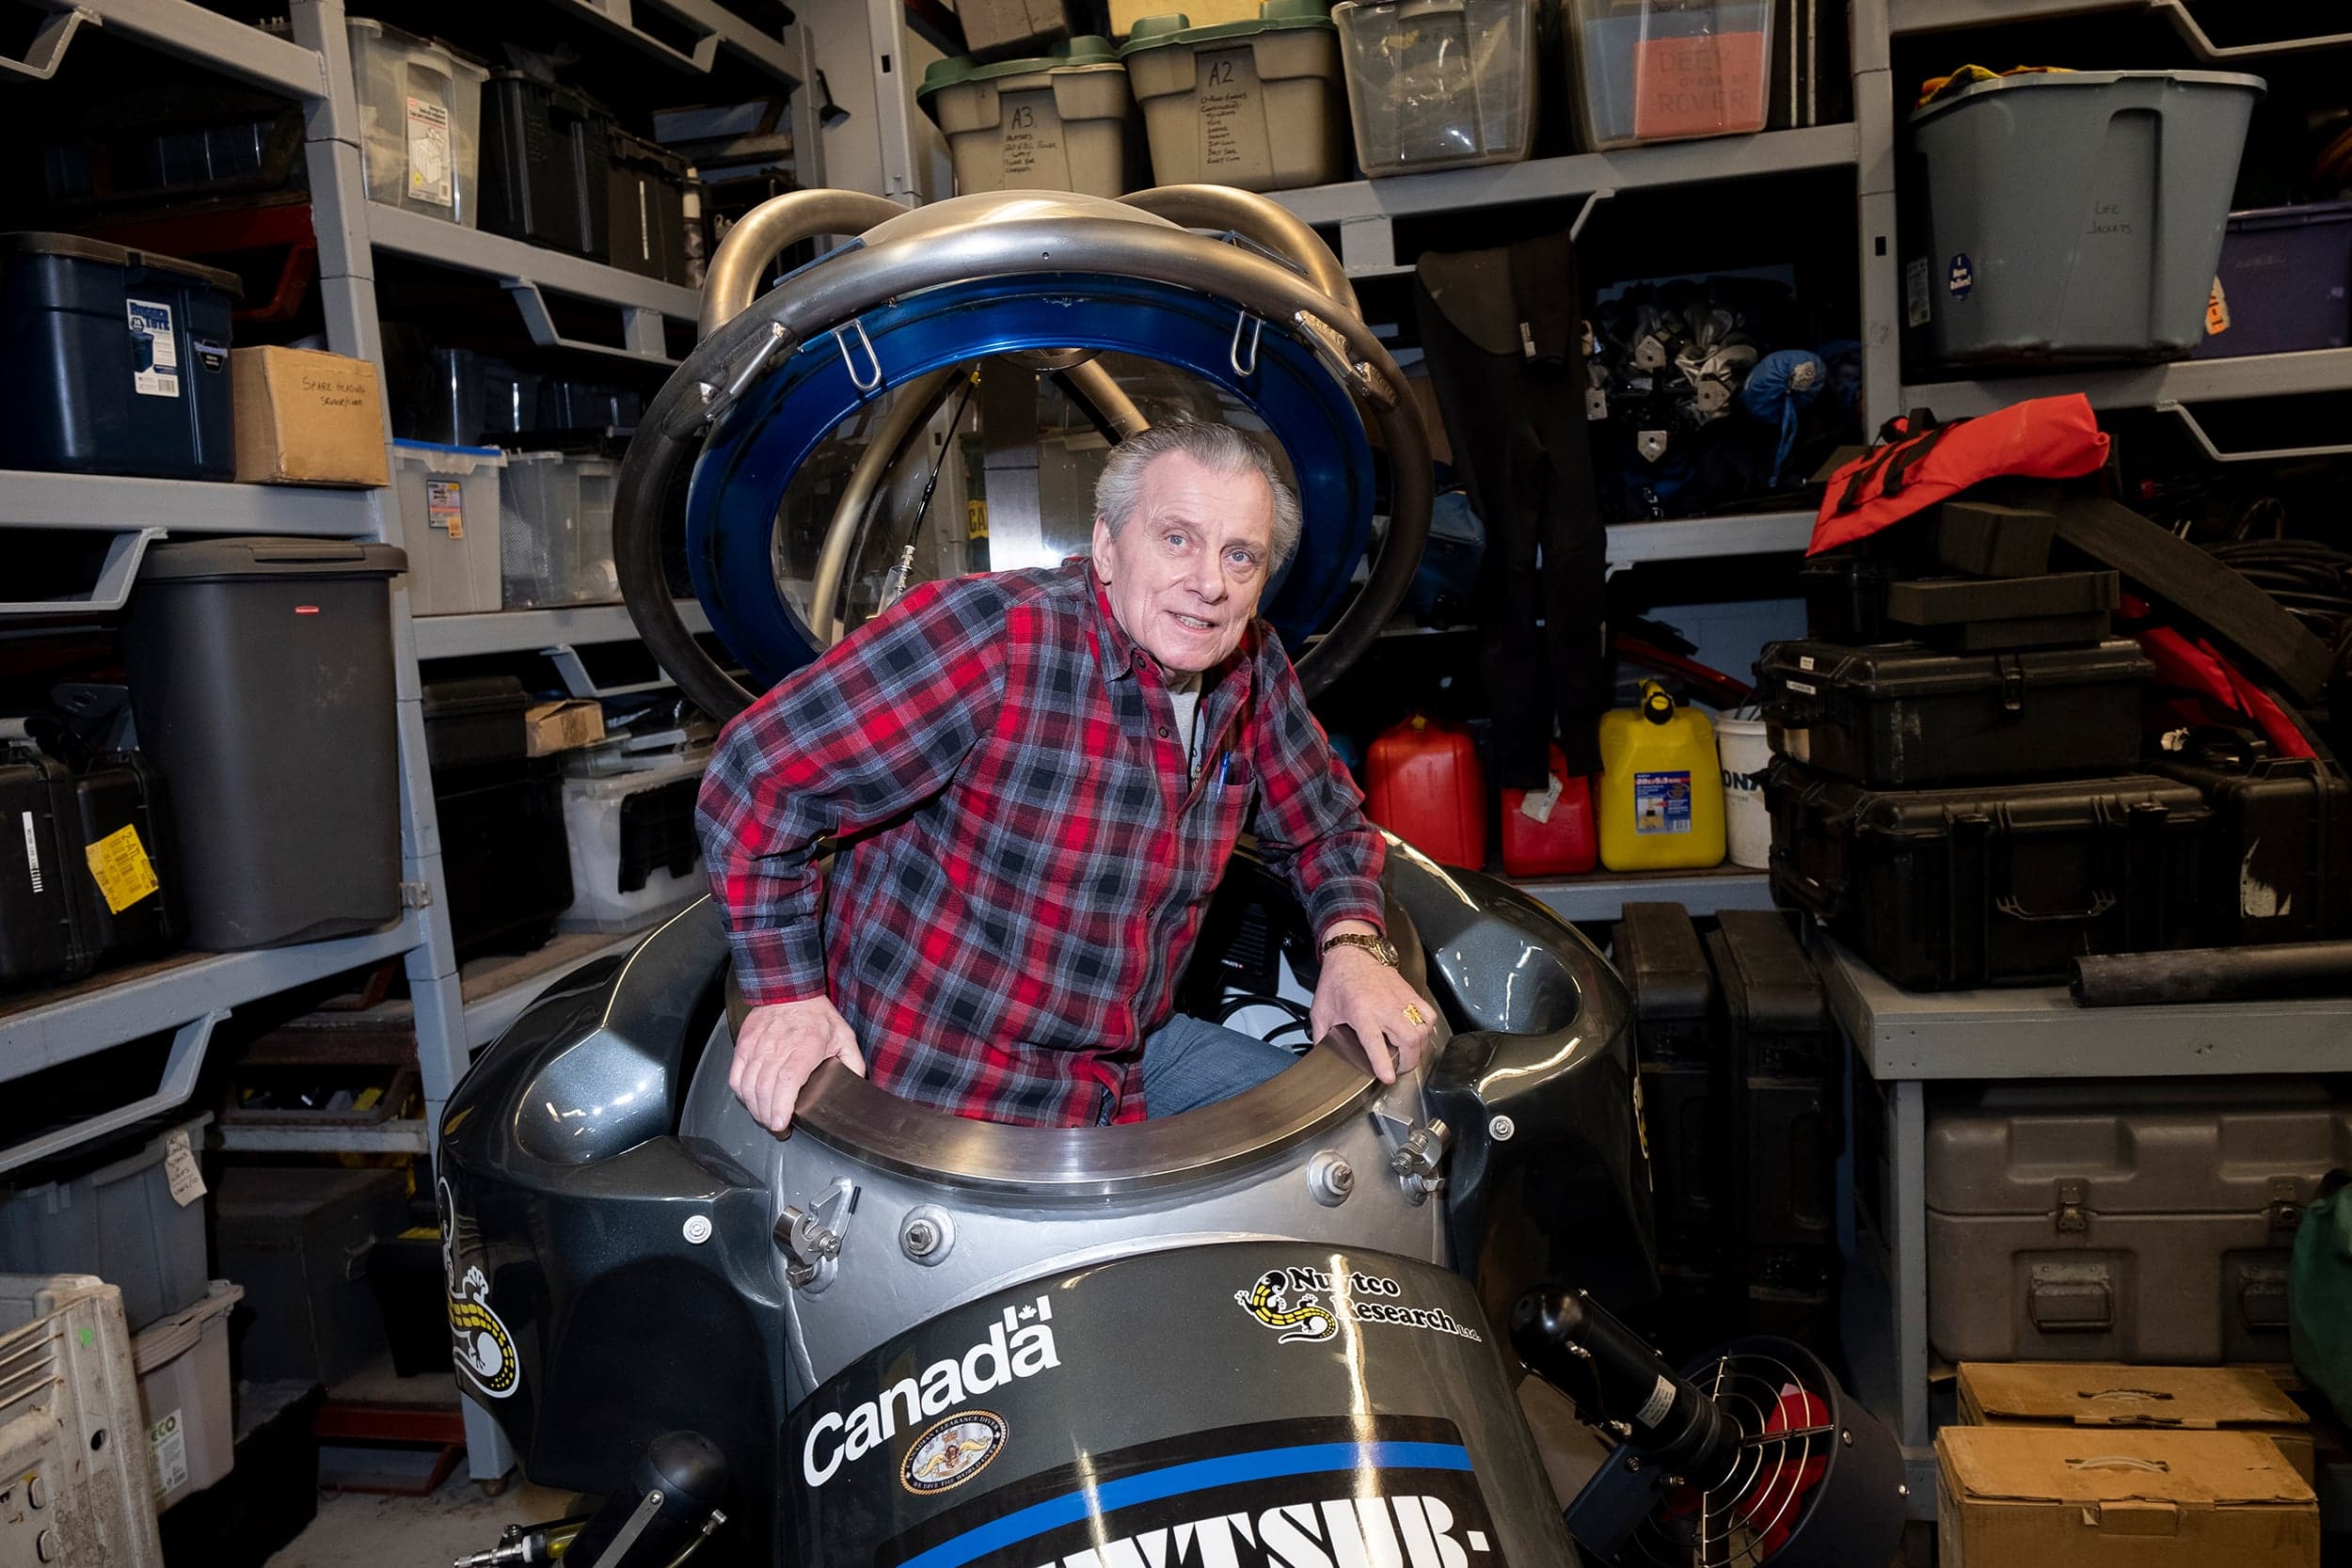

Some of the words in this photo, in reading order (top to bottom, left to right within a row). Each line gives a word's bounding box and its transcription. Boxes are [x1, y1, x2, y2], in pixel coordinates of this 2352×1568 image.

[1208, 61, 1235, 88] A2
[1011, 105, 1034, 130] A3
[1292, 1268, 1399, 1296] Nutco
[803, 1320, 1062, 1488] Canada
